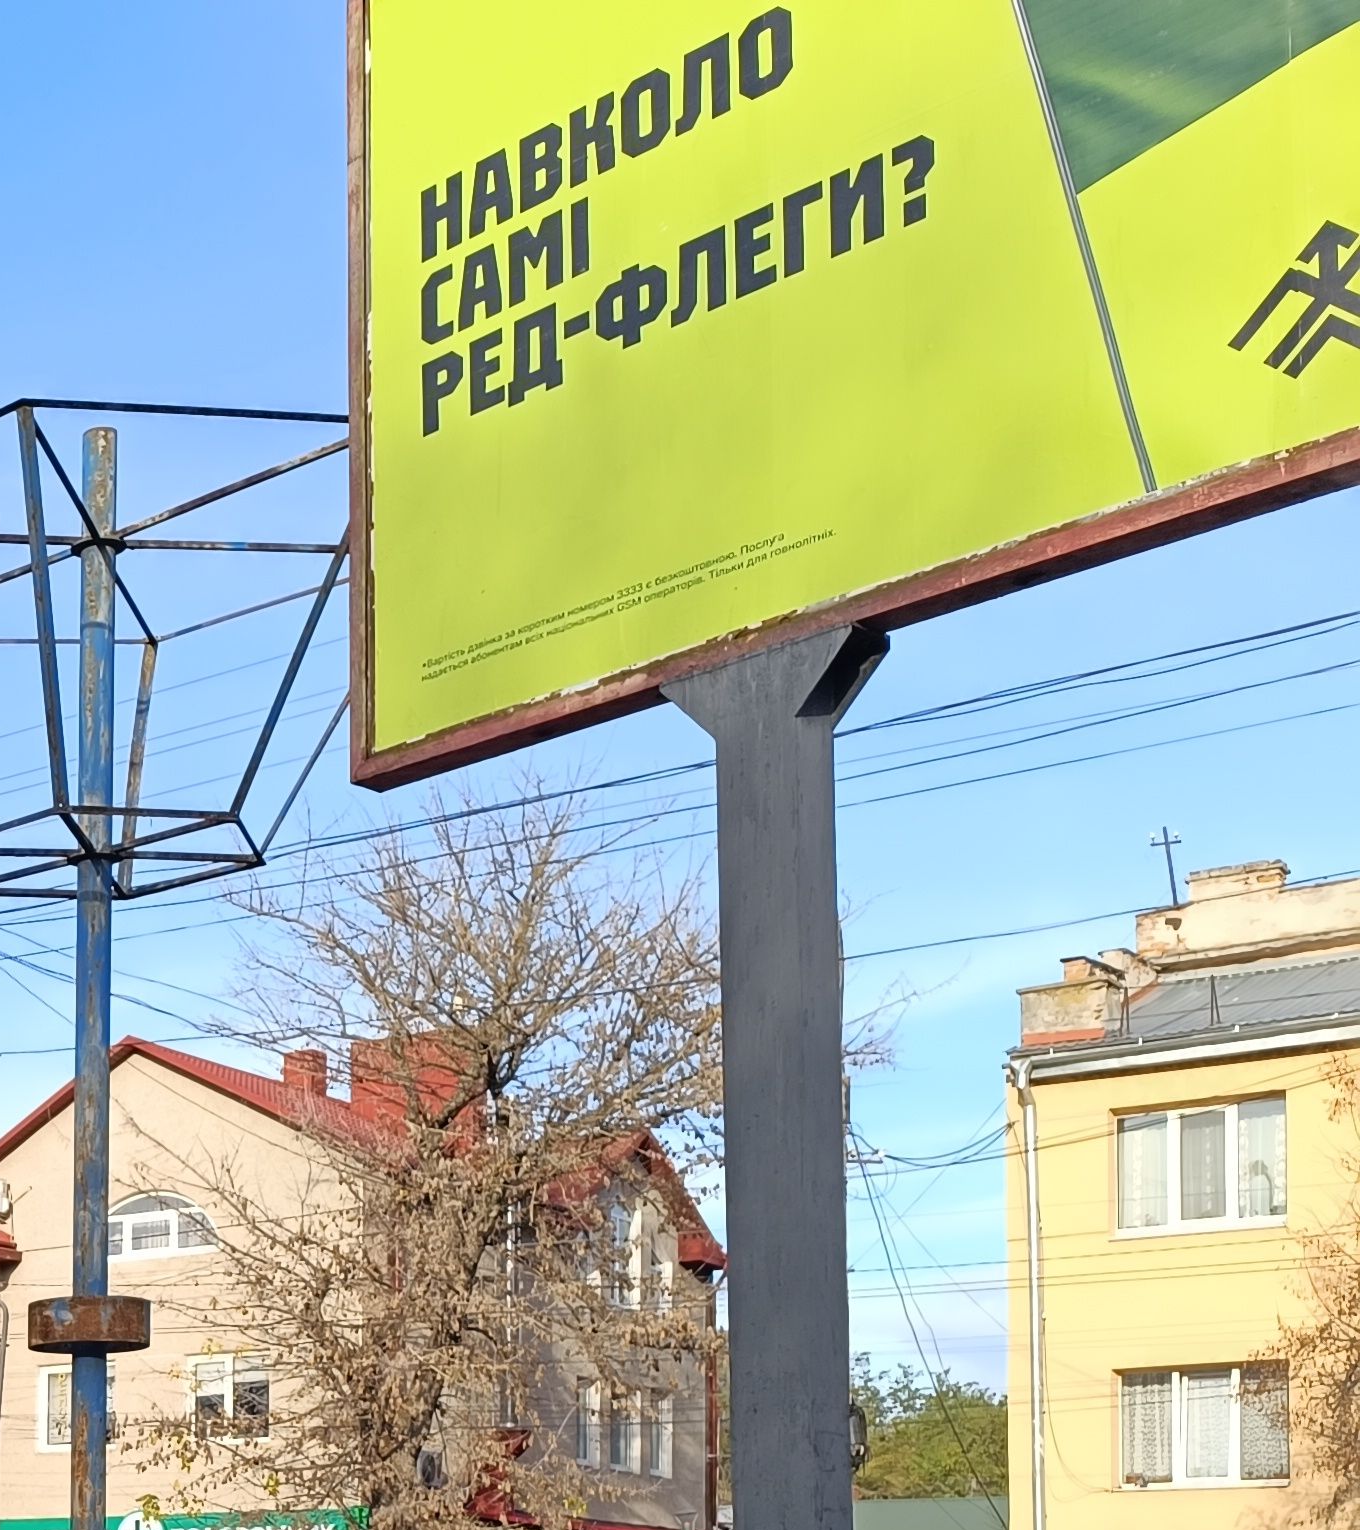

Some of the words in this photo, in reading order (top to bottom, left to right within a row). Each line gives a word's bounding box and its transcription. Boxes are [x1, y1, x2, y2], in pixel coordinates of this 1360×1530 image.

[421, 6, 793, 263] НАВКОЛО
[421, 197, 589, 344] САМІ
[421, 135, 935, 437] РЕД-ФЛЕГИ?
[617, 582, 643, 600] 3333
